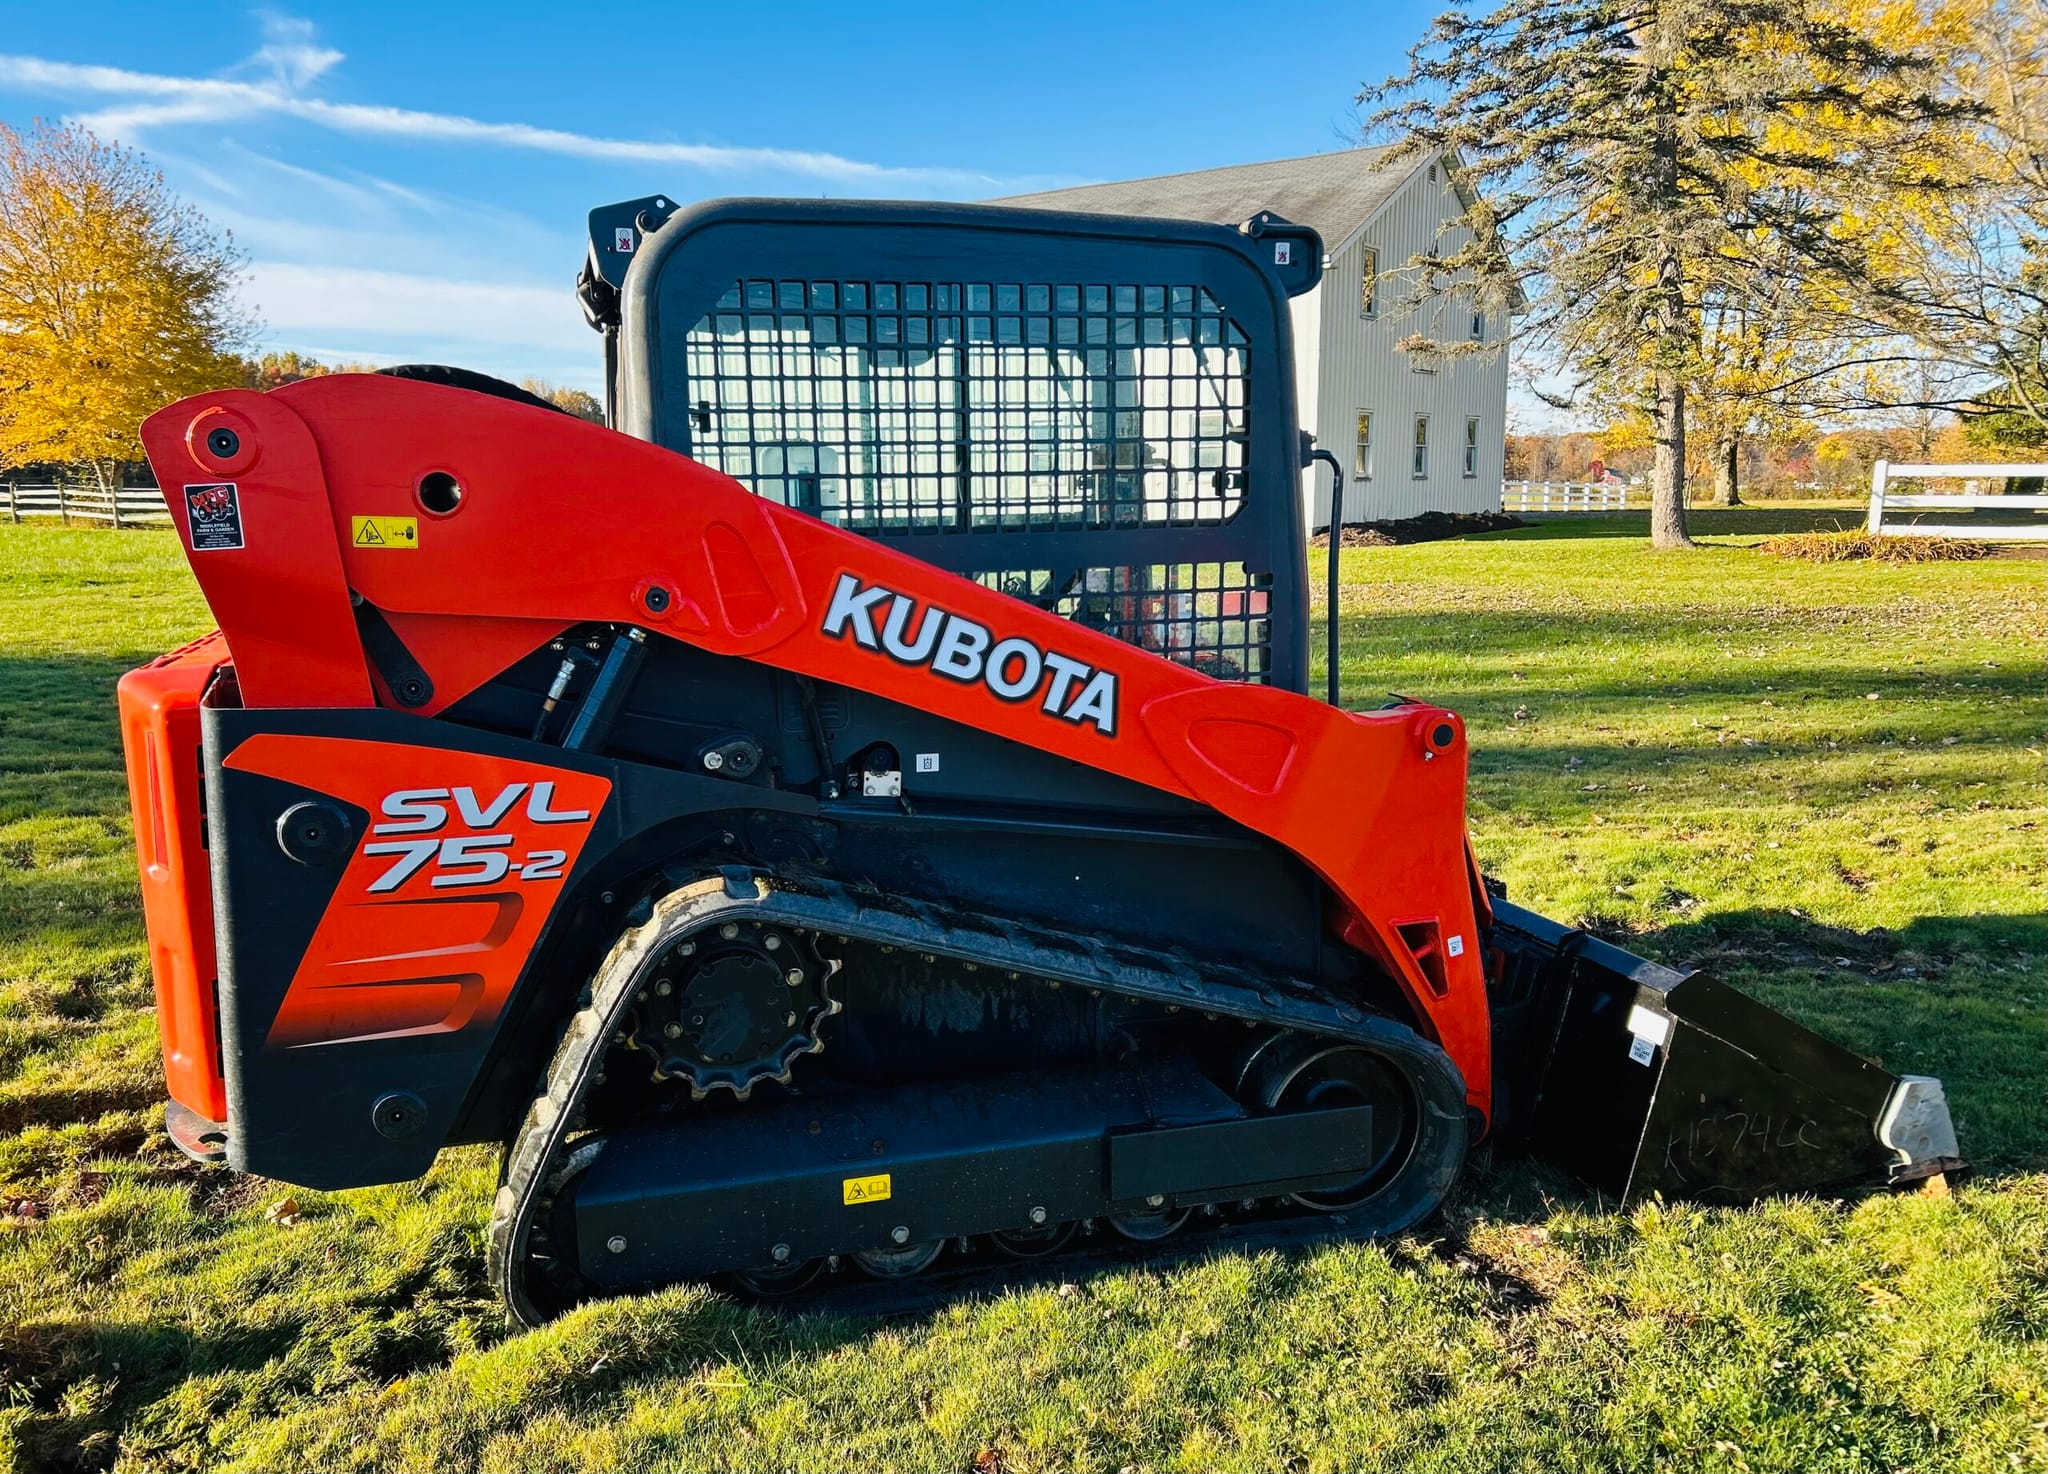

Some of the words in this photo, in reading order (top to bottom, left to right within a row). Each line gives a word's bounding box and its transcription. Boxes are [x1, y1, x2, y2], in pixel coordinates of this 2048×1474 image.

[821, 572, 1118, 736] KUBOTA
[373, 781, 591, 836] SVL
[363, 834, 567, 893] 75-2
